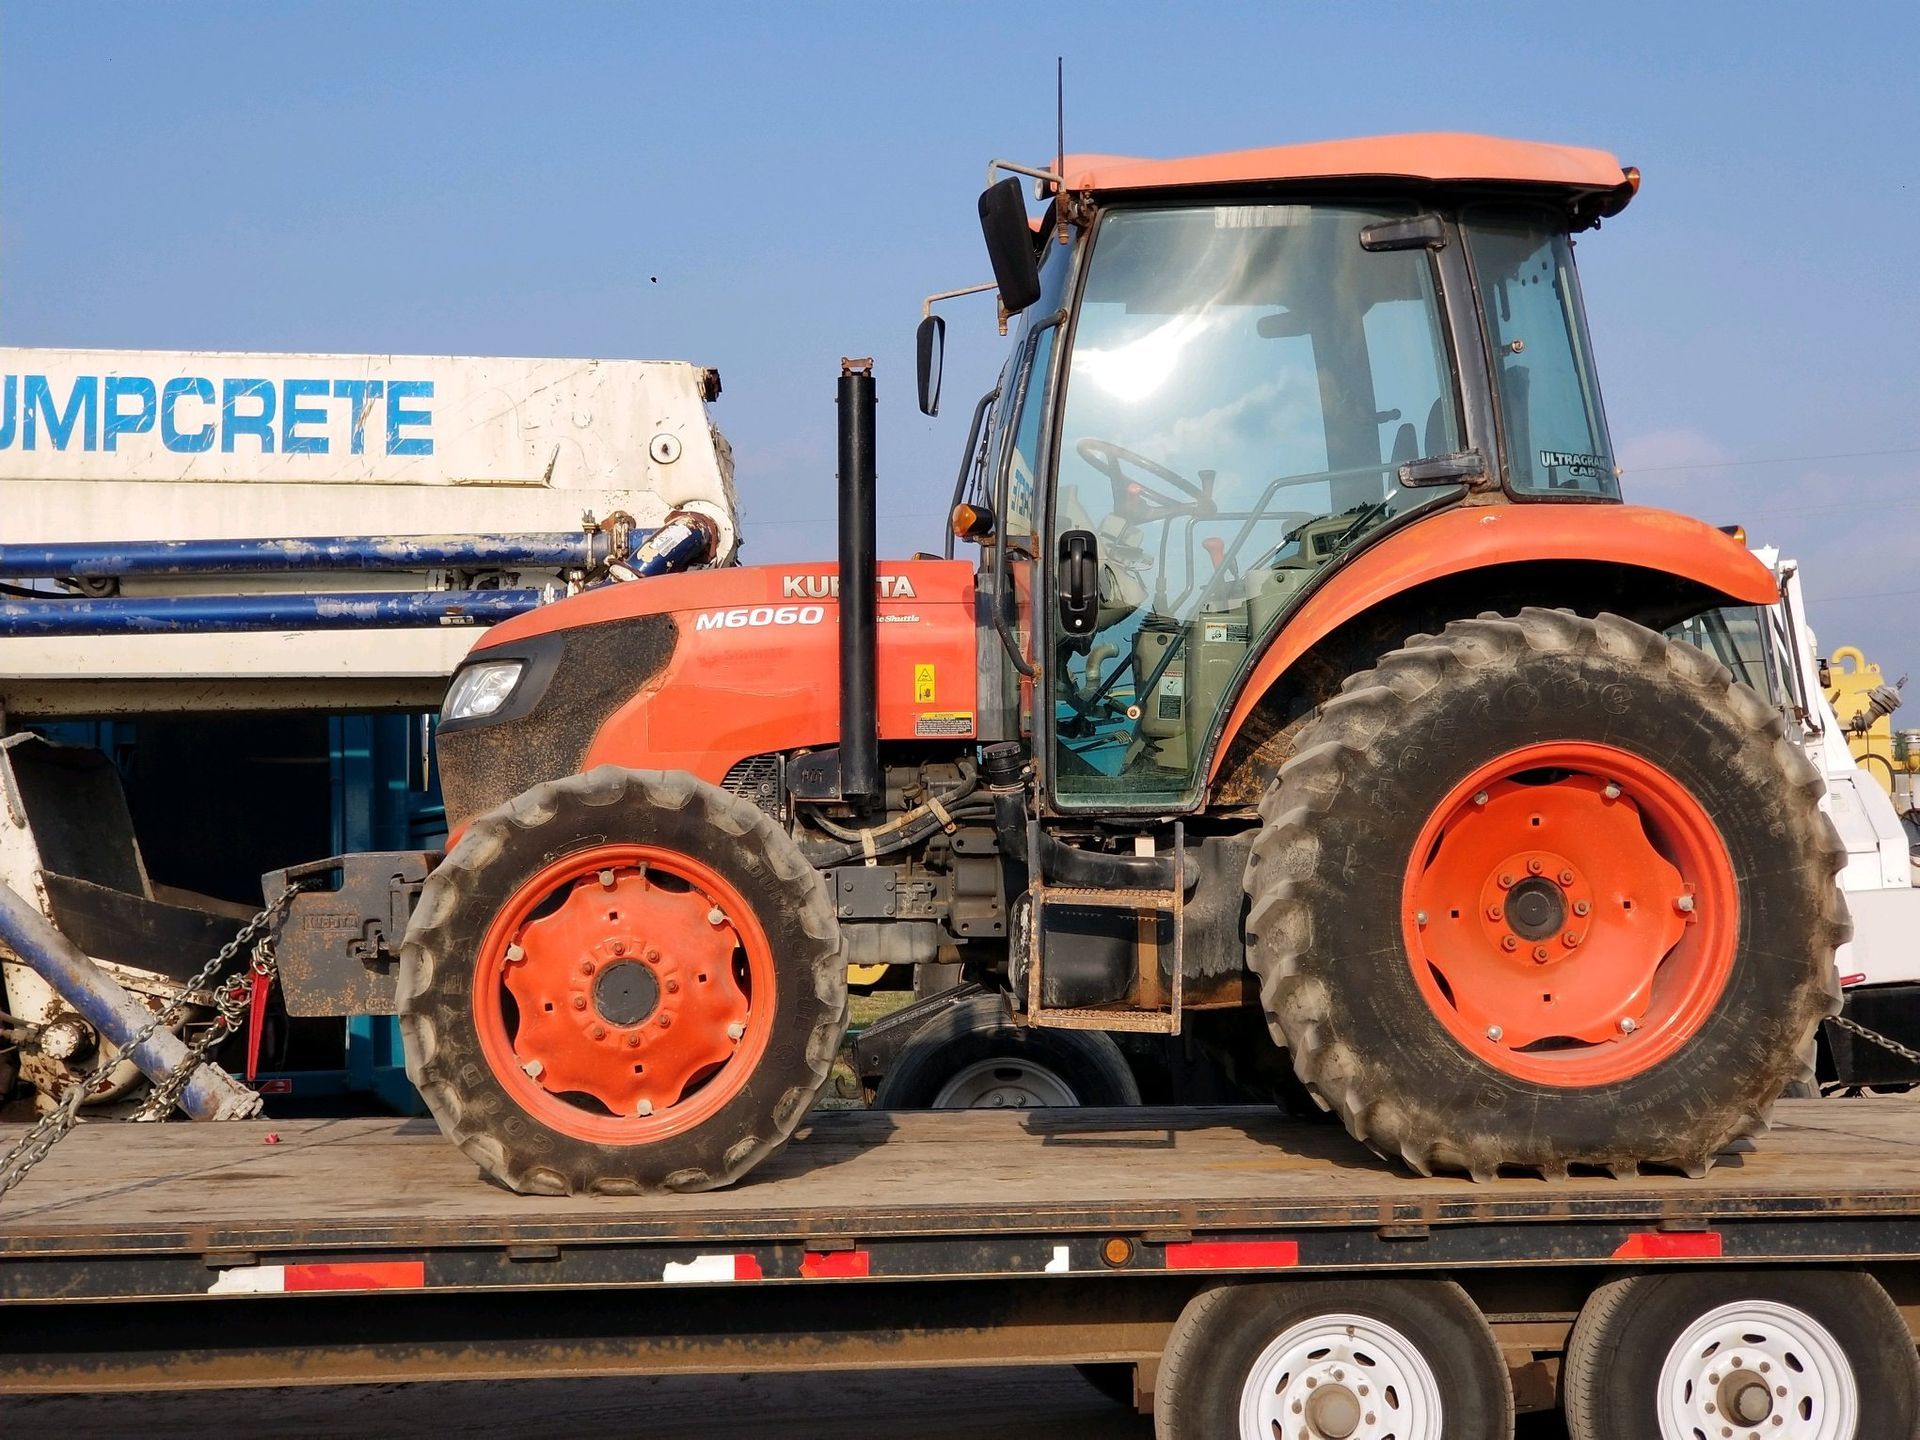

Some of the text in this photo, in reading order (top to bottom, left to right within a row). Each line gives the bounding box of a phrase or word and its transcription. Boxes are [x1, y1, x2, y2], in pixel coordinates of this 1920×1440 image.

[1569, 465, 1597, 477] CAB
[783, 575, 916, 598] KUTA
[695, 606, 825, 631] M6060
